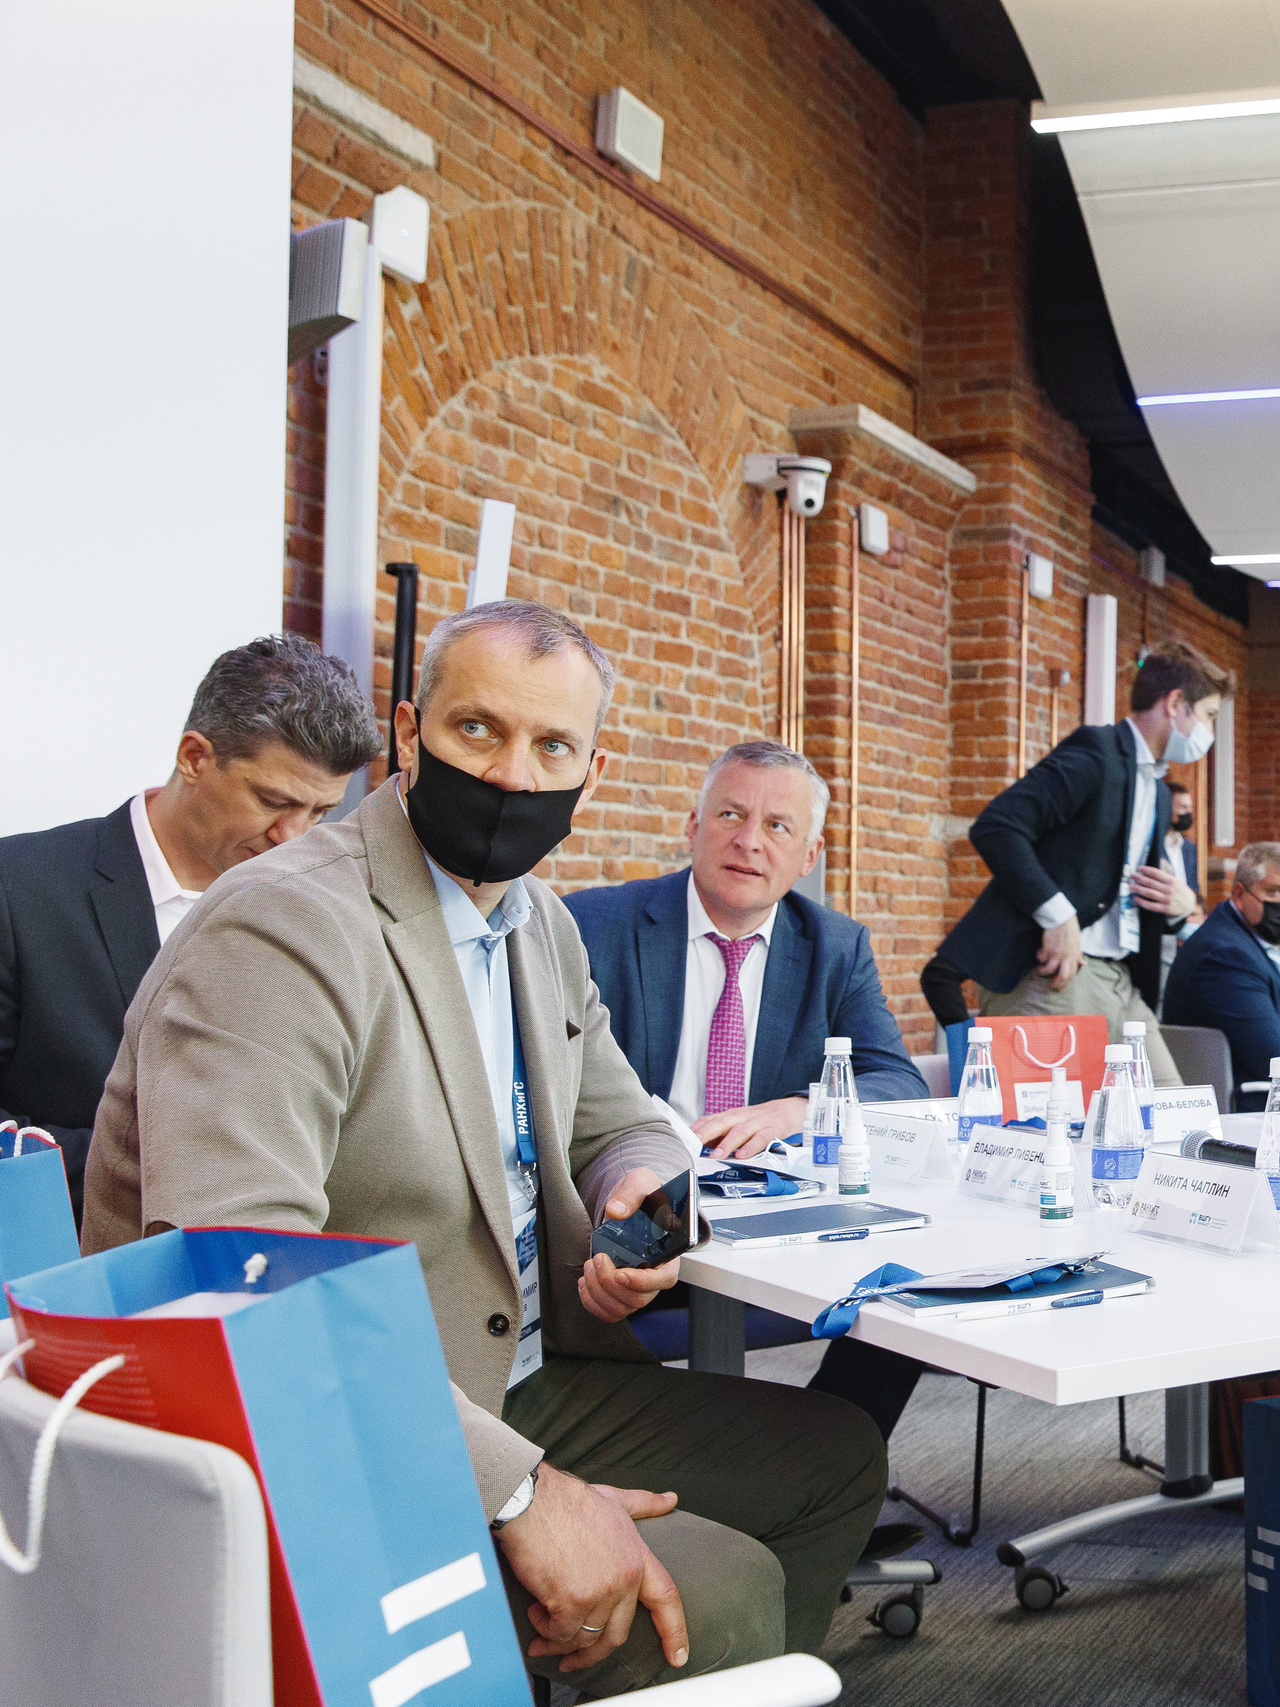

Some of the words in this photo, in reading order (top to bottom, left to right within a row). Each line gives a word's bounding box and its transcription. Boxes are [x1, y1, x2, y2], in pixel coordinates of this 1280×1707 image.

[513, 1081, 529, 1135] РАНХиГС
[887, 1128, 917, 1143] ГРИБОВ
[973, 1142, 1014, 1158] ВЛАДИМИР
[1153, 1173, 1188, 1191] НИКИТА
[1190, 1179, 1231, 1198] ЧАПЛИН
